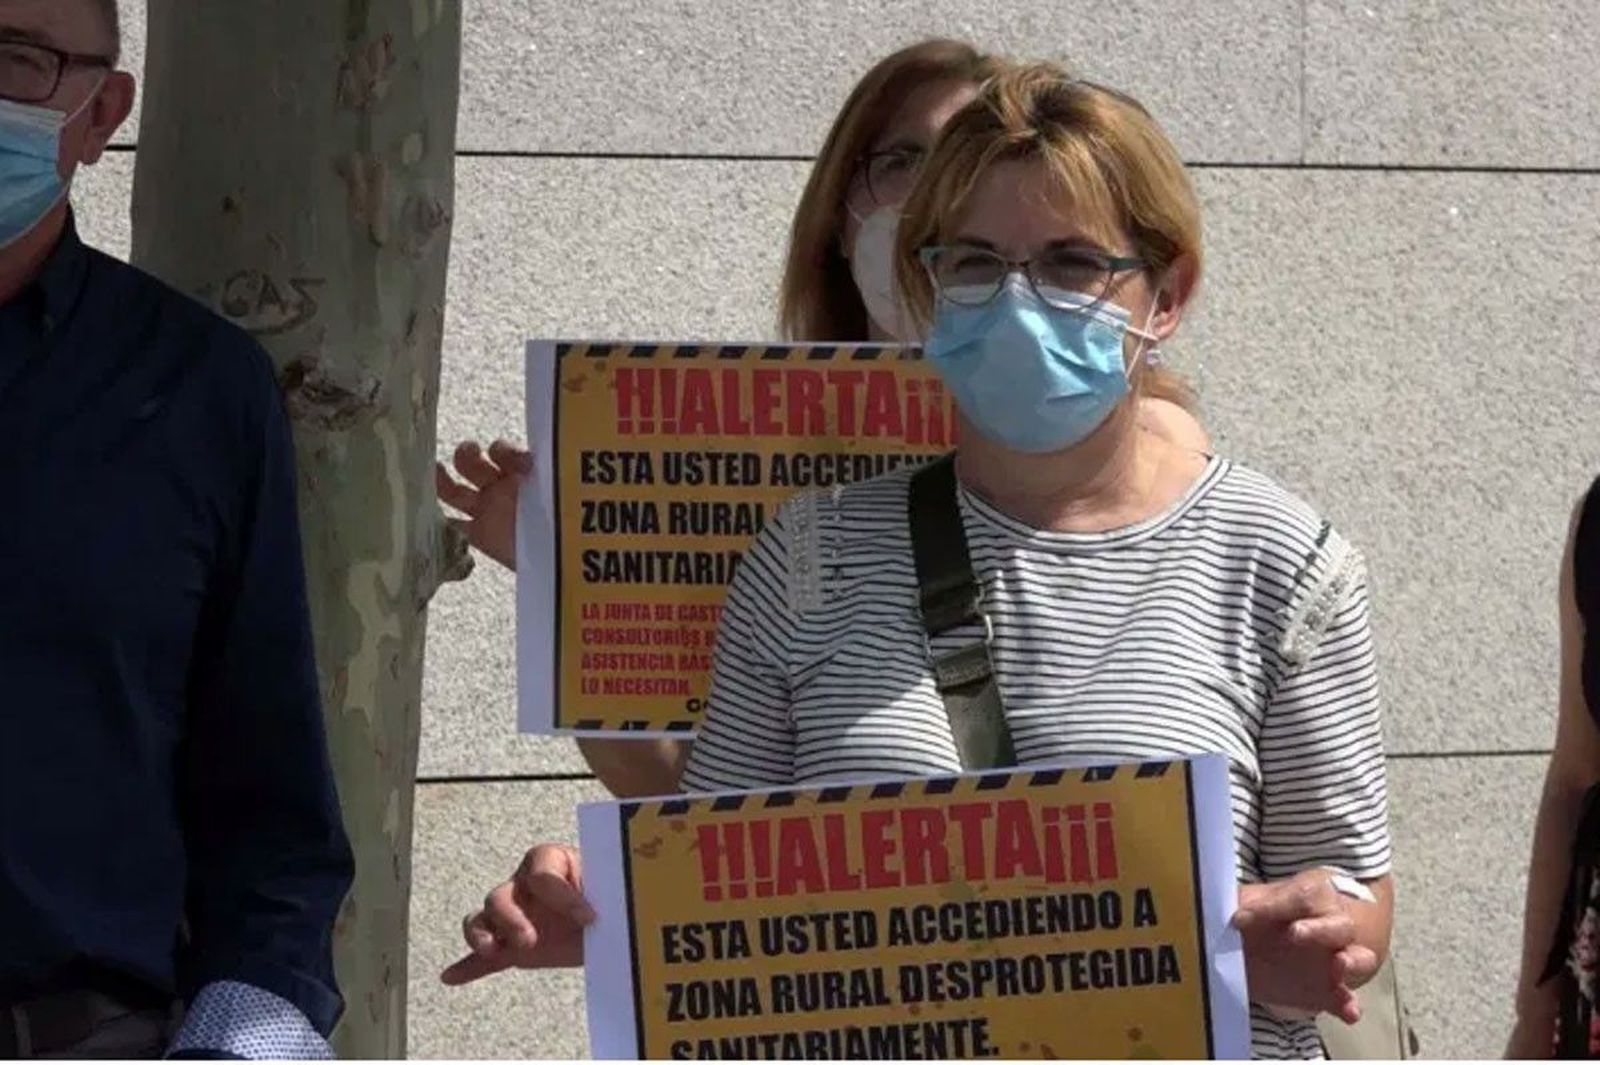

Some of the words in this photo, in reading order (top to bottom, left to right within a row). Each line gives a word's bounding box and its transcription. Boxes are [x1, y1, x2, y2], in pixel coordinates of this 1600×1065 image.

[581, 451, 654, 486] ESTA
[663, 452, 761, 487] USTED
[581, 501, 660, 536] ZONA
[581, 603, 600, 620] LA
[605, 603, 650, 620] JUNTA
[654, 604, 673, 621] DE
[581, 628, 701, 647] CONSULTORIOS
[581, 653, 675, 671] ASISTENCIA
[581, 677, 599, 695] LO
[661, 919, 752, 964] ESTA
[758, 908, 878, 957] USTED
[887, 891, 1122, 947] ACCEDIENDO
[1133, 887, 1158, 927] A
[665, 977, 763, 1023] ZONA
[771, 966, 892, 1015] RURAL
[899, 944, 1182, 1003] DESPROTEGIDA
[671, 1016, 1000, 1061] SANITARIAMENTE.
